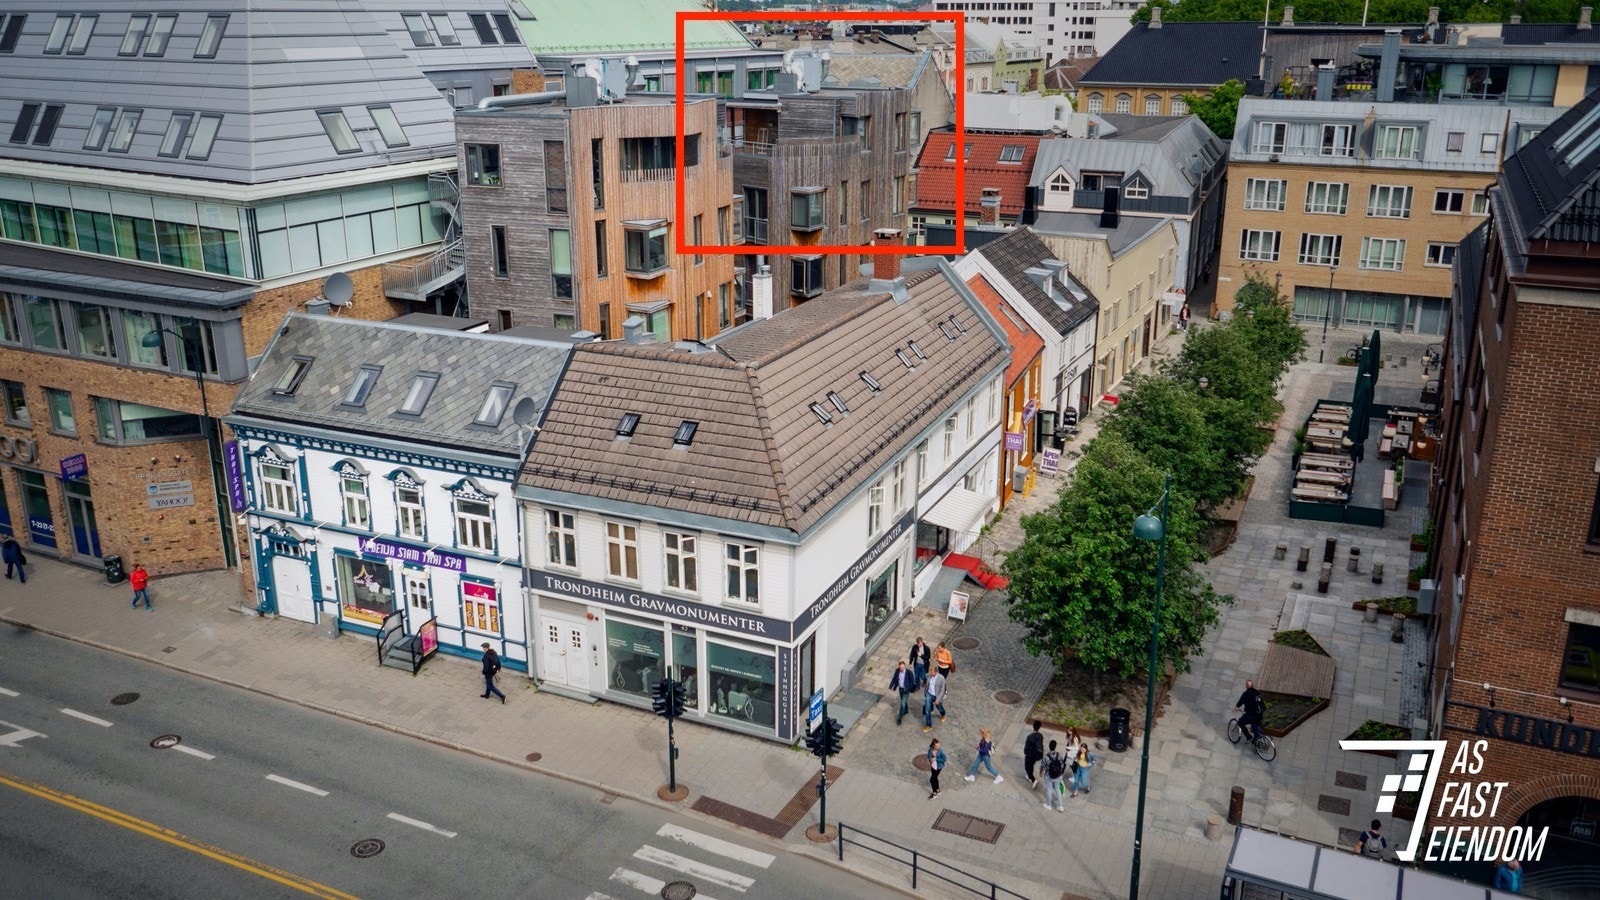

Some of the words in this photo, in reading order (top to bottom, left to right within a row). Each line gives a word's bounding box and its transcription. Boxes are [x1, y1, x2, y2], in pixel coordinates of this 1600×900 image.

[1007, 437, 1022, 445] THAI
[1043, 458, 1058, 468] THAI
[397, 547, 419, 561] SIAM
[422, 551, 442, 566] THAI
[444, 556, 462, 570] SPA
[544, 576, 625, 604] TRONDHEIM
[629, 594, 766, 633] GRAVMONUMENTER
